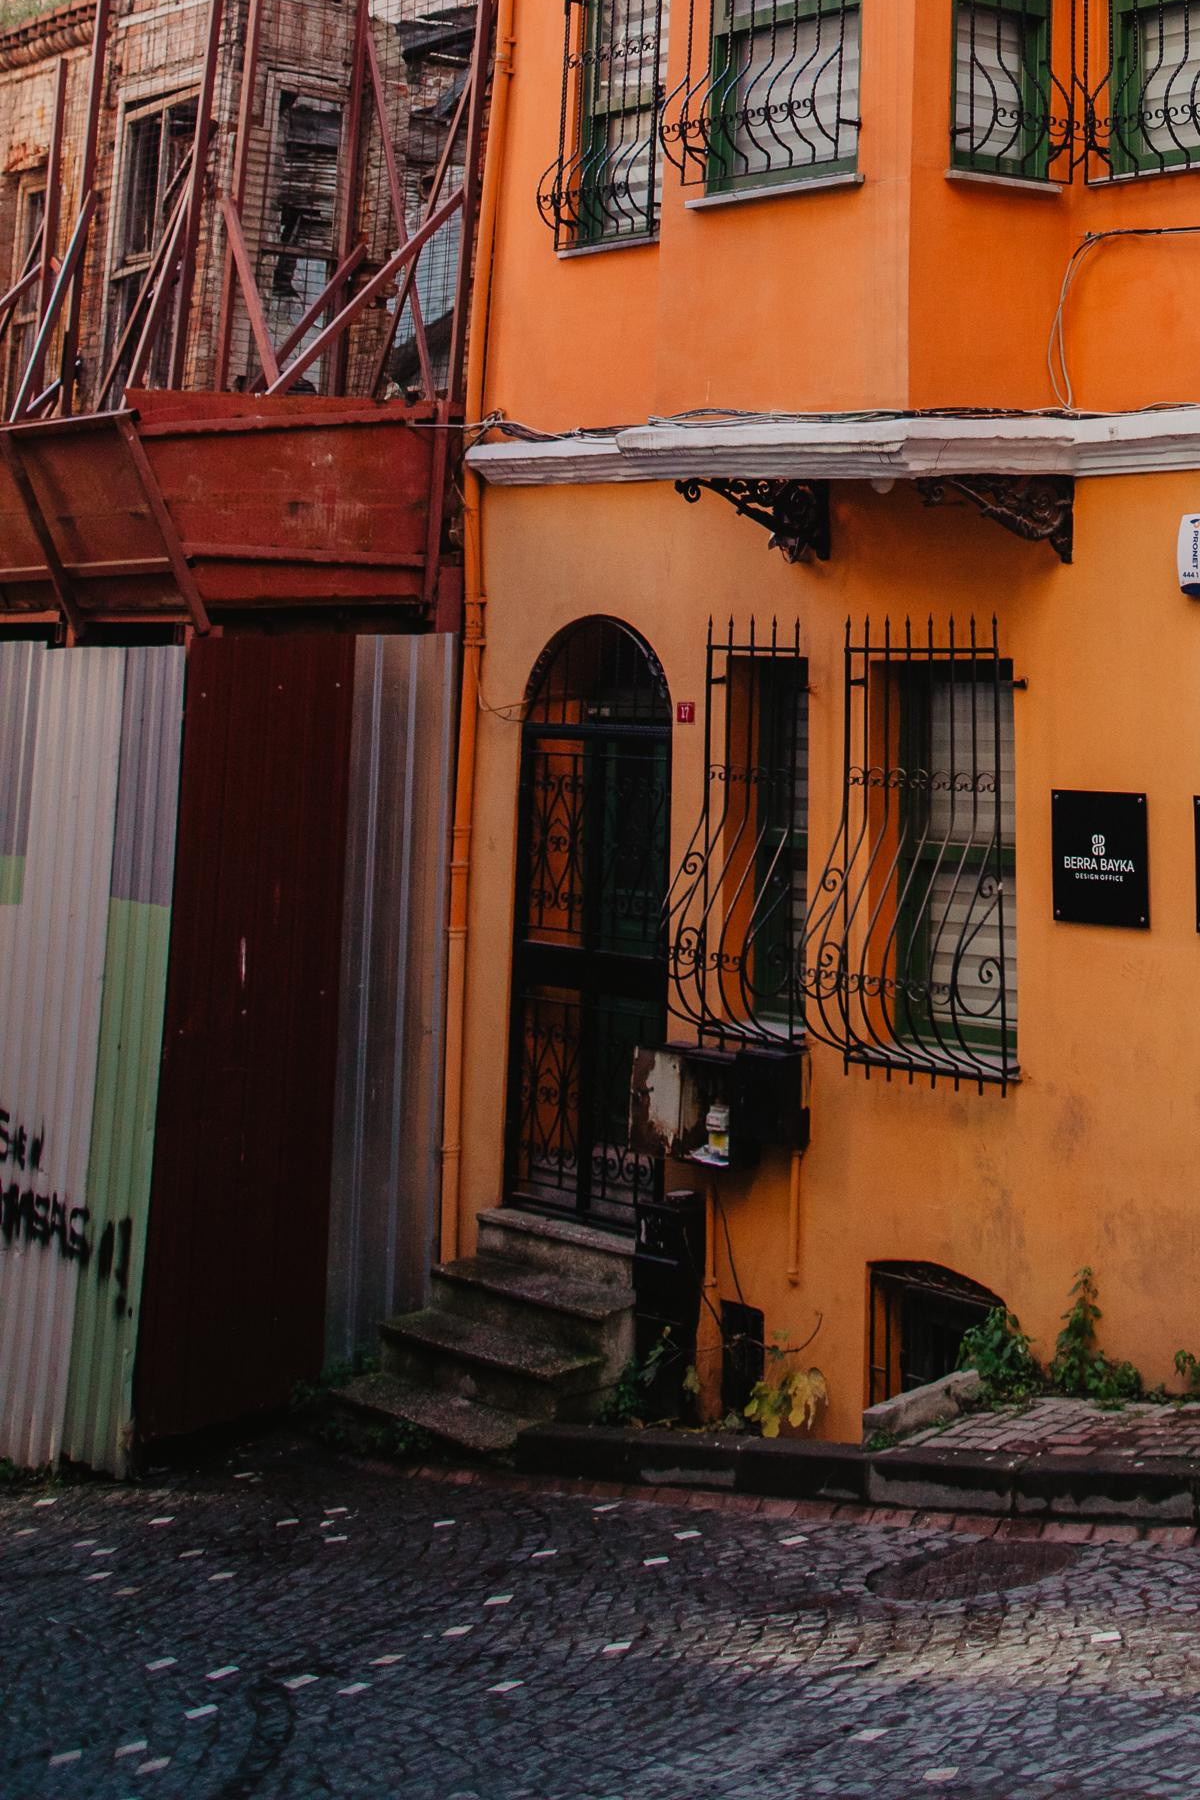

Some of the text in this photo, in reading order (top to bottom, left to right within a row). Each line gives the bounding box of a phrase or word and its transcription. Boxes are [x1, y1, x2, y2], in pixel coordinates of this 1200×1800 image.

[1182, 571, 1195, 579] 444
[681, 706, 690, 720] 17
[1064, 856, 1135, 873] BERRA BAYKA
[1075, 872, 1124, 882] DESIGN OFFICE
